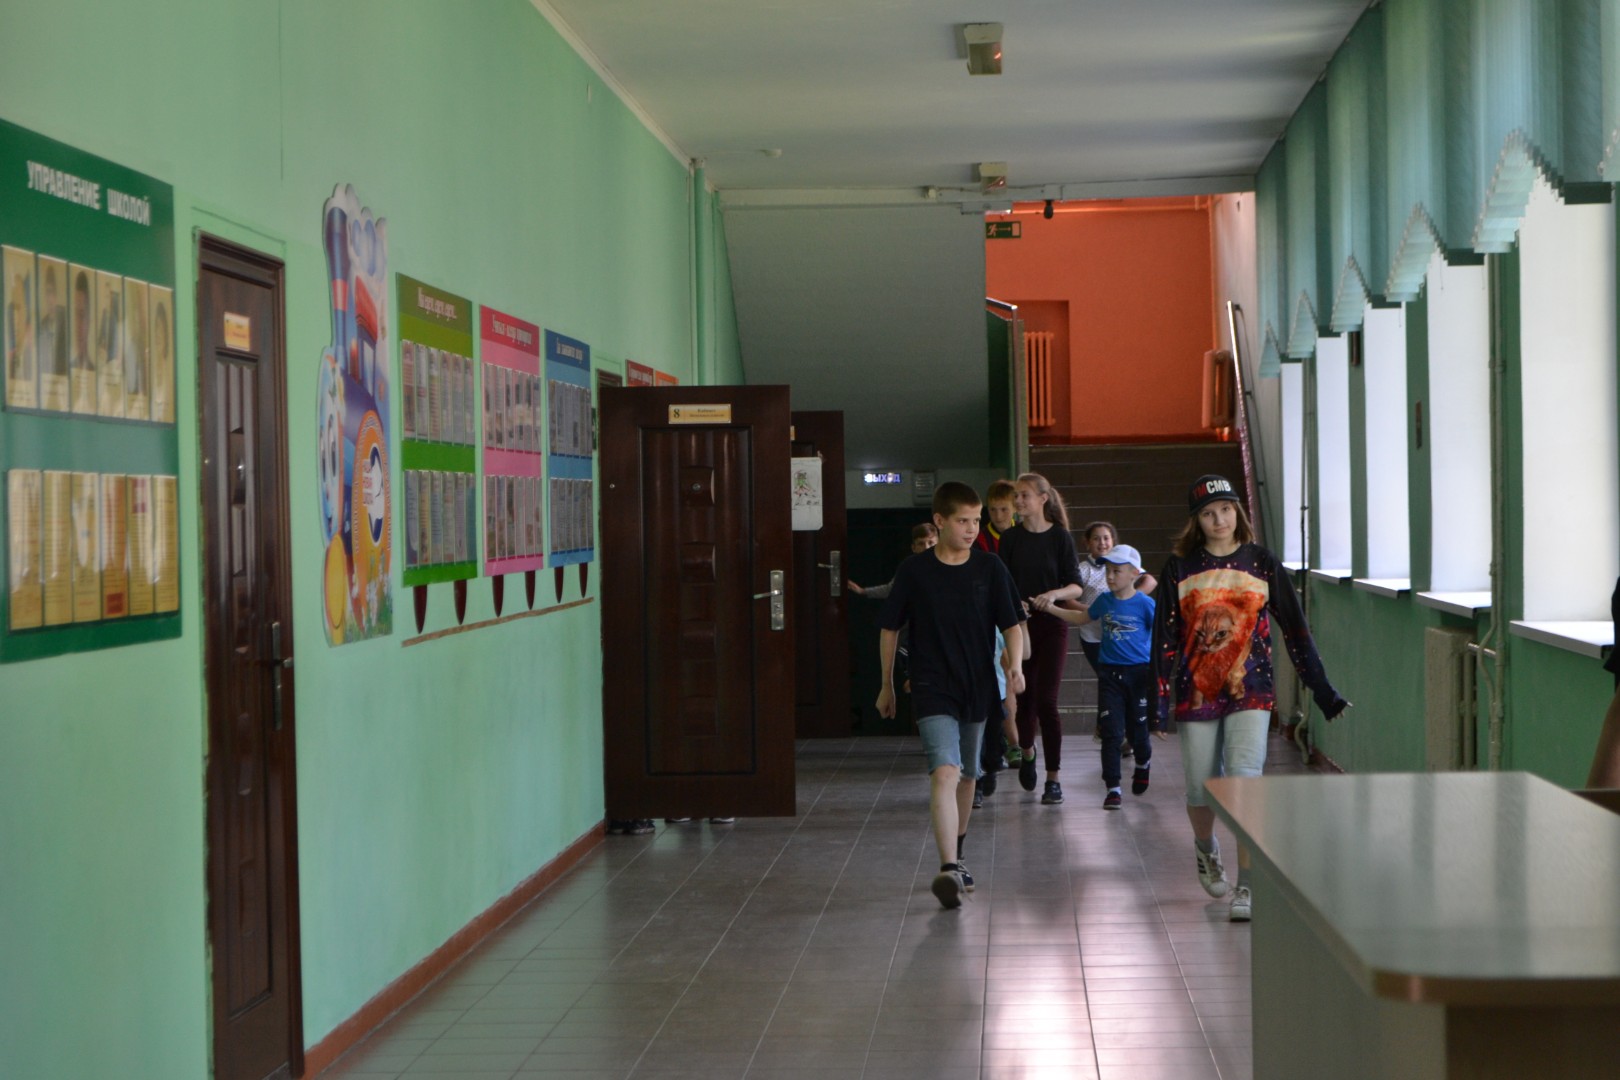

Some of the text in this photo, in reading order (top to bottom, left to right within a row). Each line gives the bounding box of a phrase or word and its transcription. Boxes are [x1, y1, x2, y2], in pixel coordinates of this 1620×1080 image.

[27, 160, 150, 227] УПРАВЛЕНИЕ ШКОЛОЙ
[673, 408, 680, 419] 8
